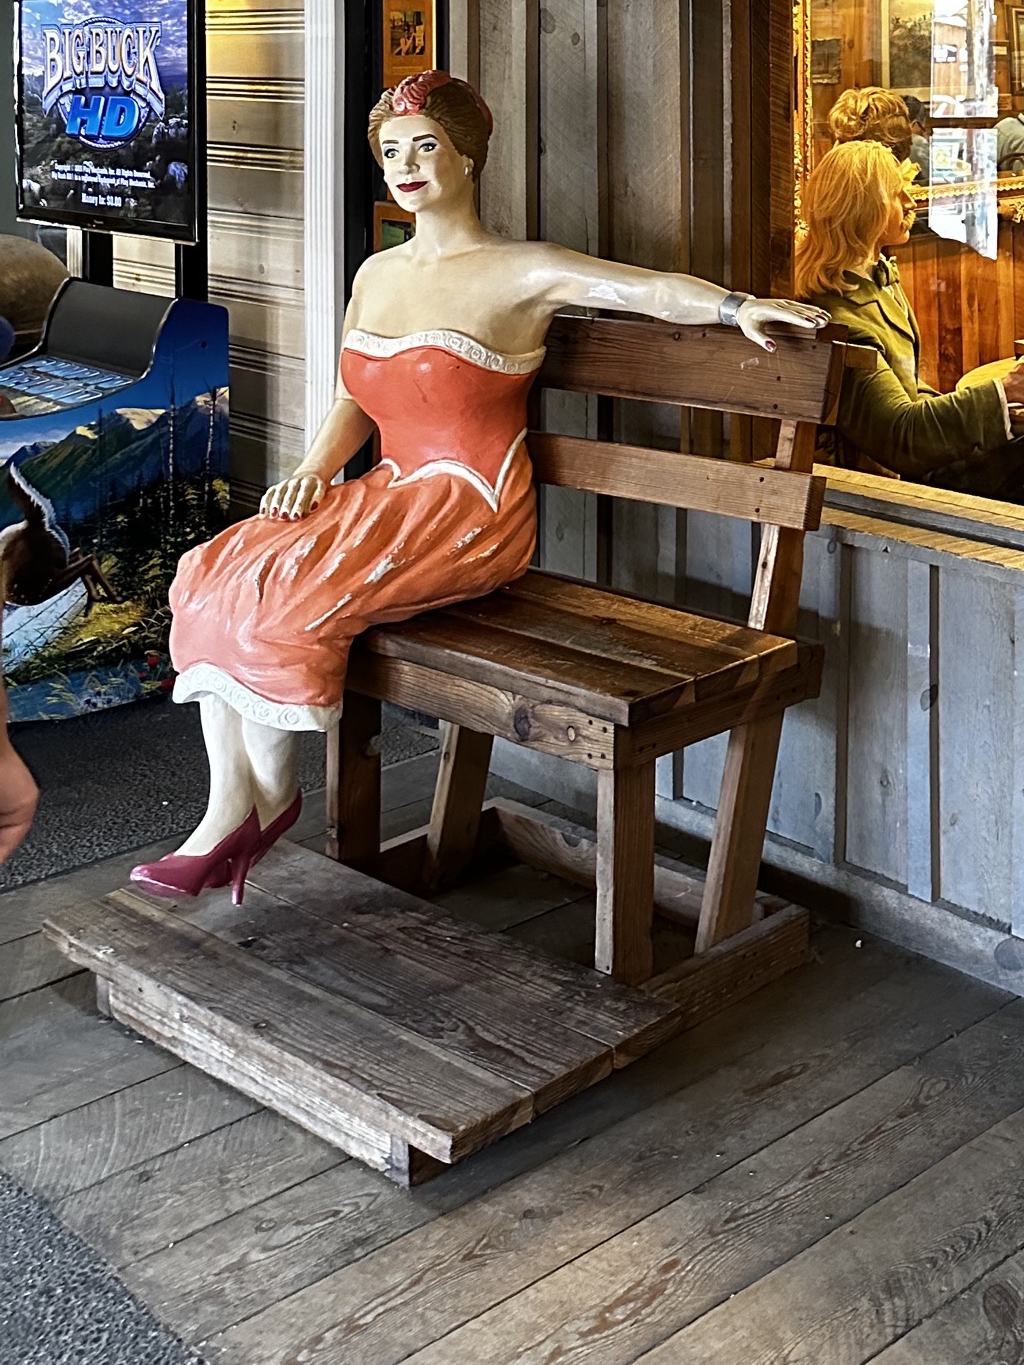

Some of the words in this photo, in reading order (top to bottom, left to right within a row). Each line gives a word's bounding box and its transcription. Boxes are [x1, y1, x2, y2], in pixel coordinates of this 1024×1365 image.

[43, 25, 86, 94] BIG
[88, 24, 163, 101] BUCK
[66, 94, 140, 137] HD
